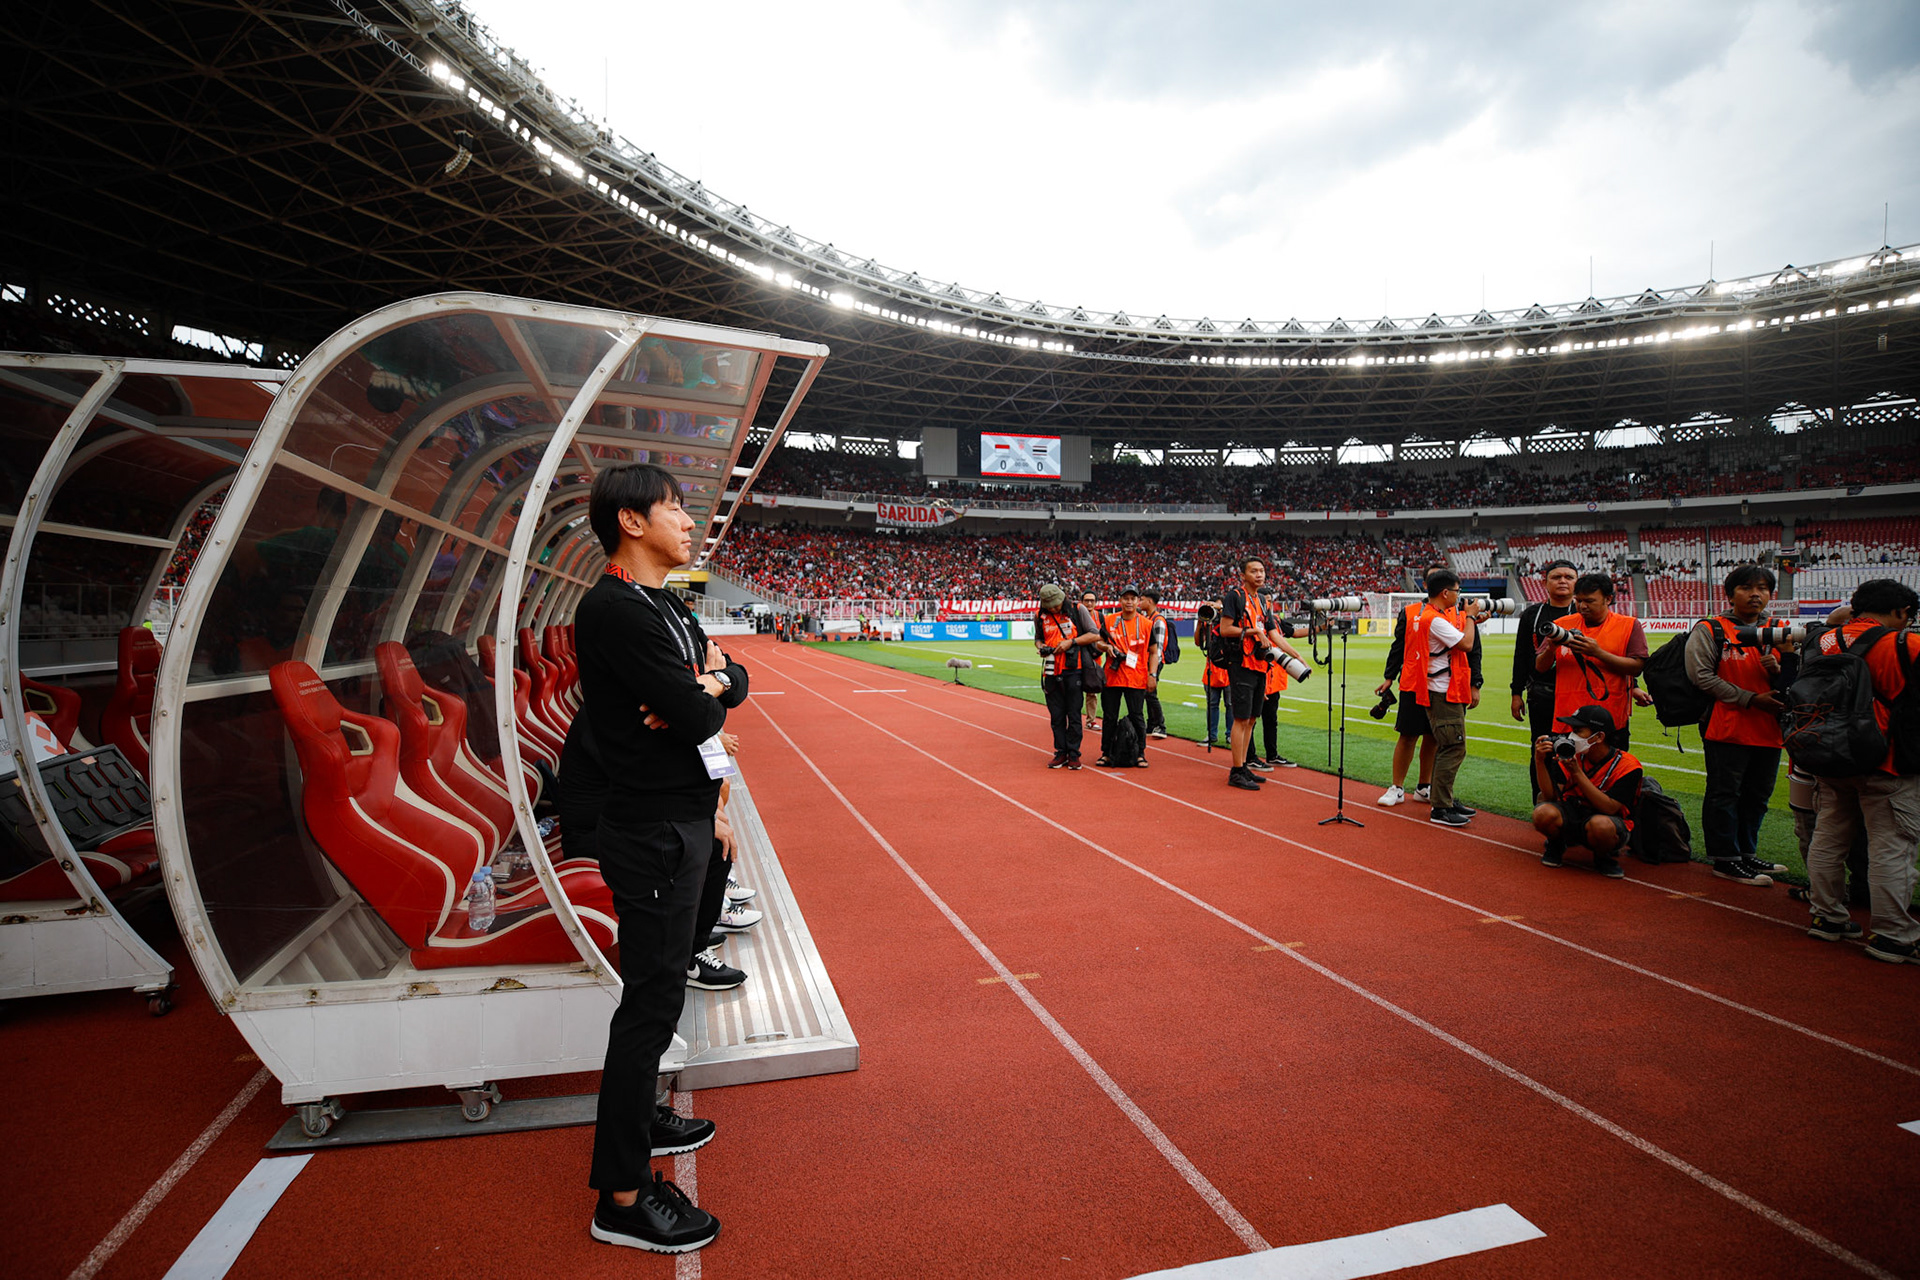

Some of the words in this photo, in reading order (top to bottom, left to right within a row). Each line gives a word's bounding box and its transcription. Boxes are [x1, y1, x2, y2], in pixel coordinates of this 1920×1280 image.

[1000, 460, 1007, 470] 0
[1037, 461, 1044, 472] 0
[877, 502, 939, 523] GARUDA
[1649, 621, 1688, 630] YANMAR
